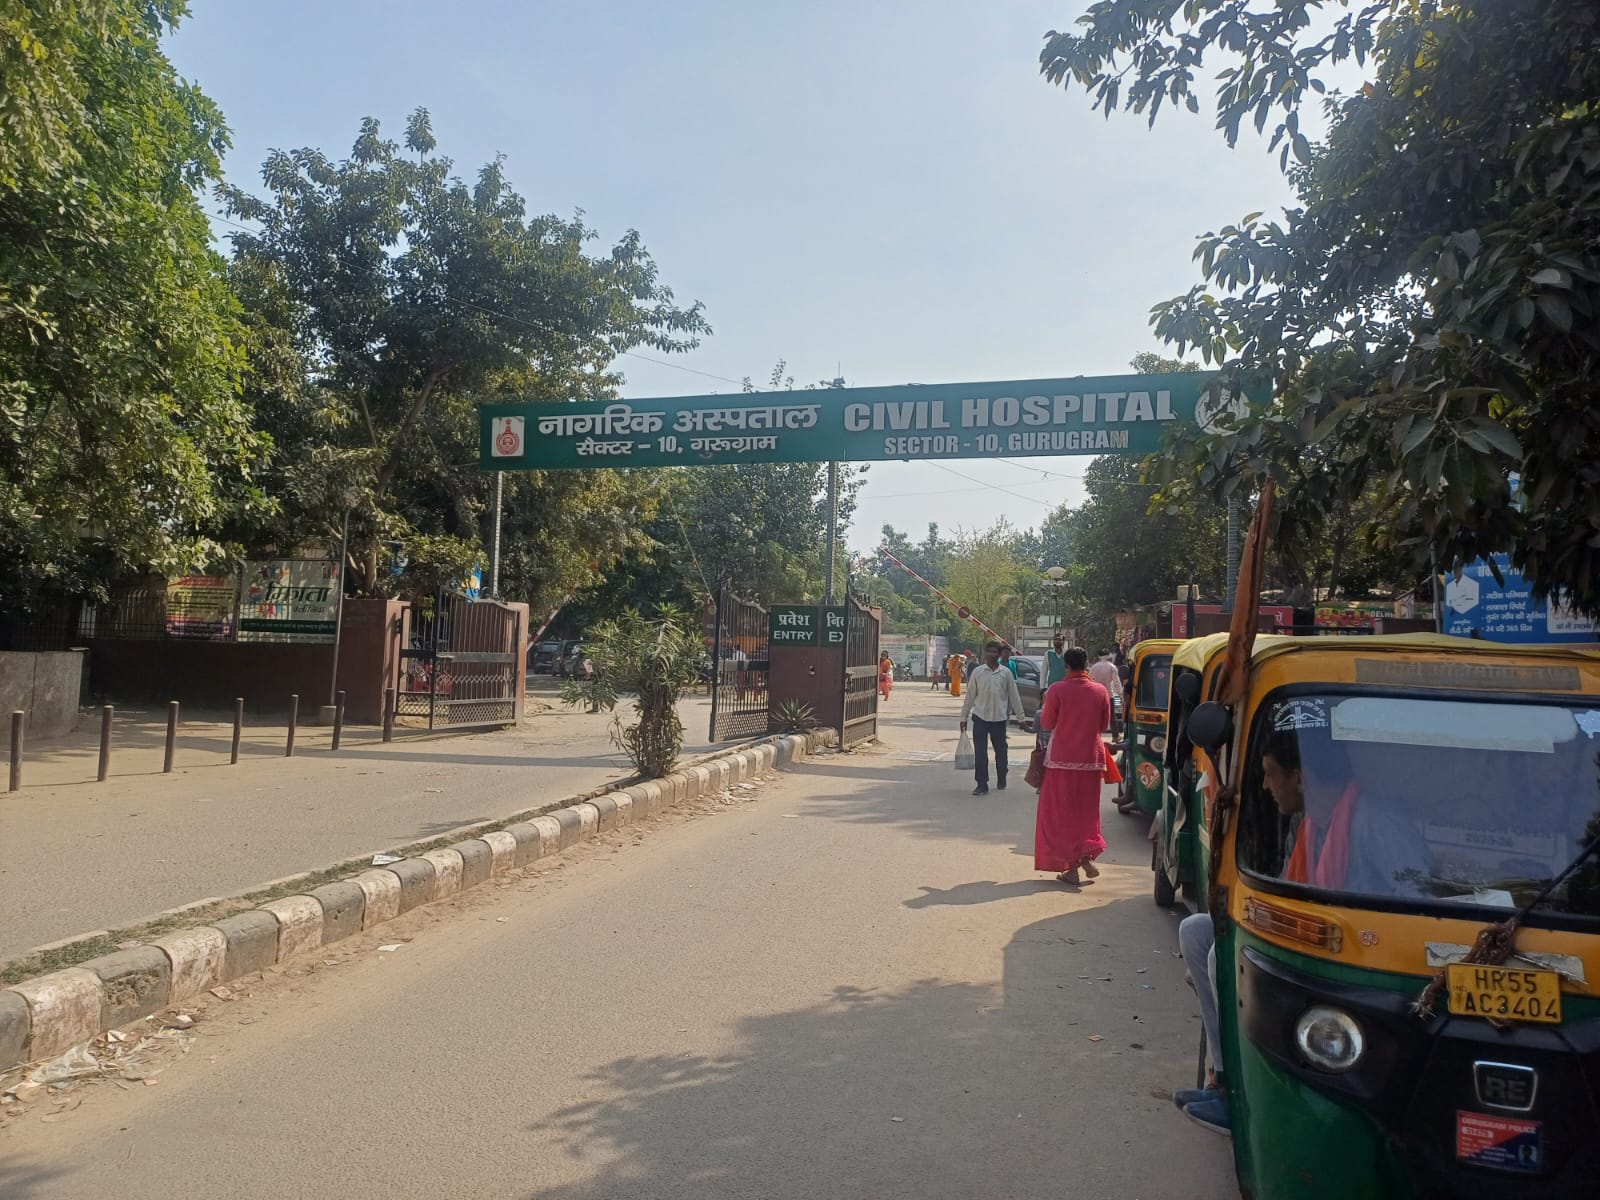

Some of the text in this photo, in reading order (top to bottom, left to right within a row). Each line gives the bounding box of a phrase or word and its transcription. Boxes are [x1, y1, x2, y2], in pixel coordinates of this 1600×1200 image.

[538, 403, 822, 436] नागरिक अस्पताल
[843, 390, 1176, 432] CIVIL HOSPITAL
[576, 436, 635, 456] सैक्टर
[658, 435, 683, 454] 10,
[884, 434, 959, 455] SECTOR
[975, 433, 1004, 454] 10,
[1008, 429, 1129, 452] GURUGRAM
[778, 611, 811, 626] प्रवेश
[773, 630, 814, 641] ENTRY
[1475, 968, 1537, 995] HR55
[1464, 992, 1558, 1019] AC3404
[1486, 1076, 1527, 1101] RE
[1508, 1124, 1537, 1135] POLICE
